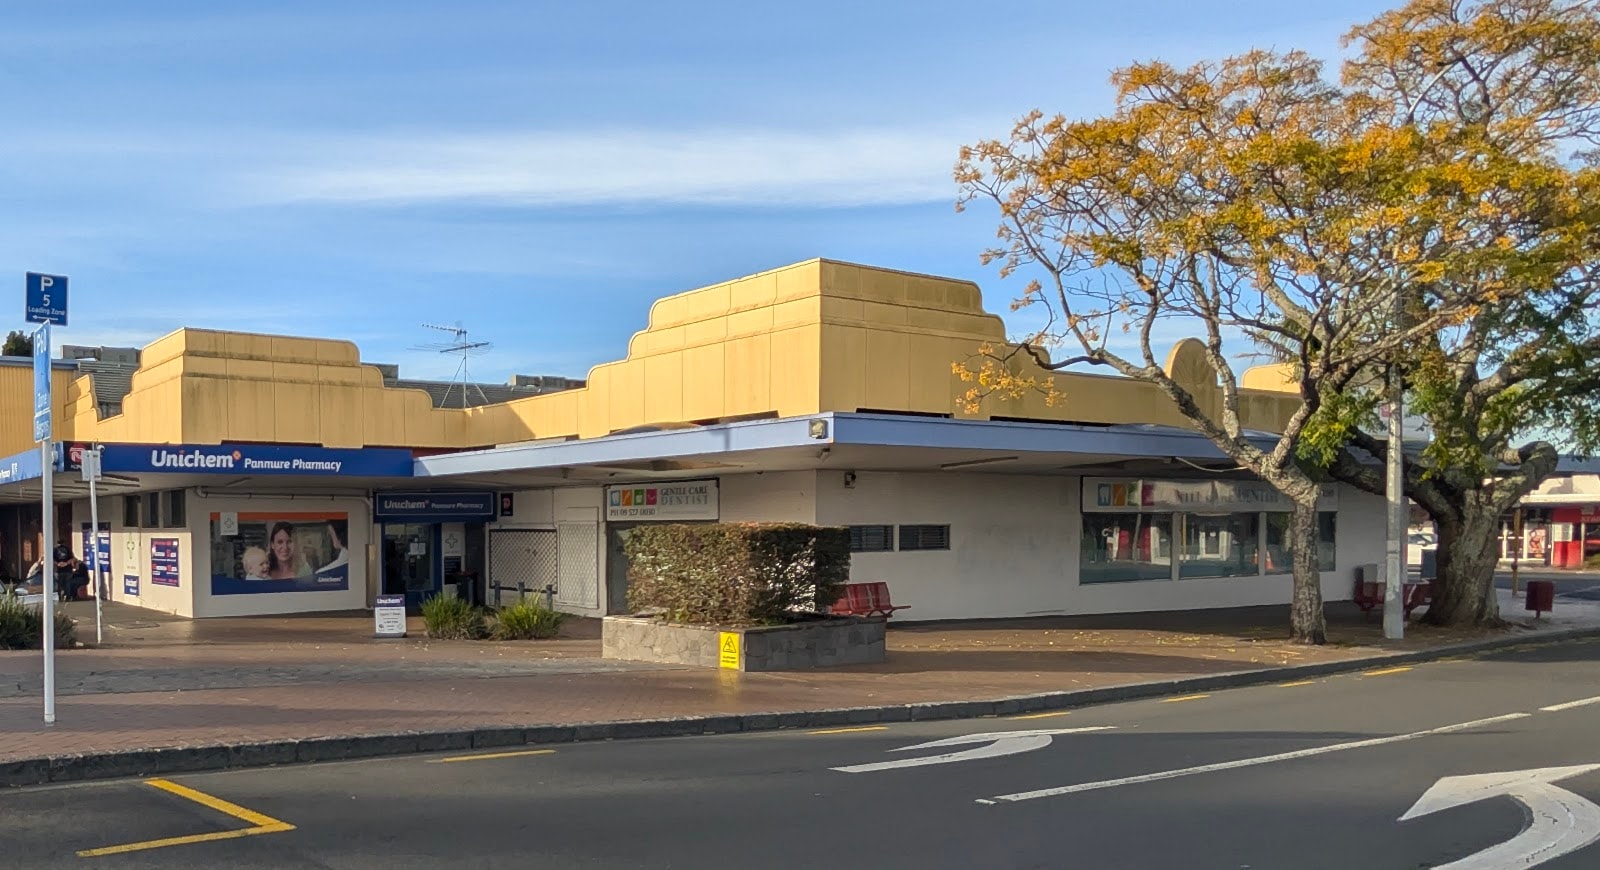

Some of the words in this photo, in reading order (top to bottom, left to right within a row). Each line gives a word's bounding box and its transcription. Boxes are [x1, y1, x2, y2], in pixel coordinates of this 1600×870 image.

[40, 276, 54, 292] P
[42, 294, 51, 307] 5
[28, 306, 50, 315] Loading
[151, 449, 234, 468] Unichem
[244, 458, 290, 469] Panmure
[292, 459, 342, 472] Pharmacy
[384, 500, 426, 509] Unichem
[660, 495, 708, 505] DENTIST
